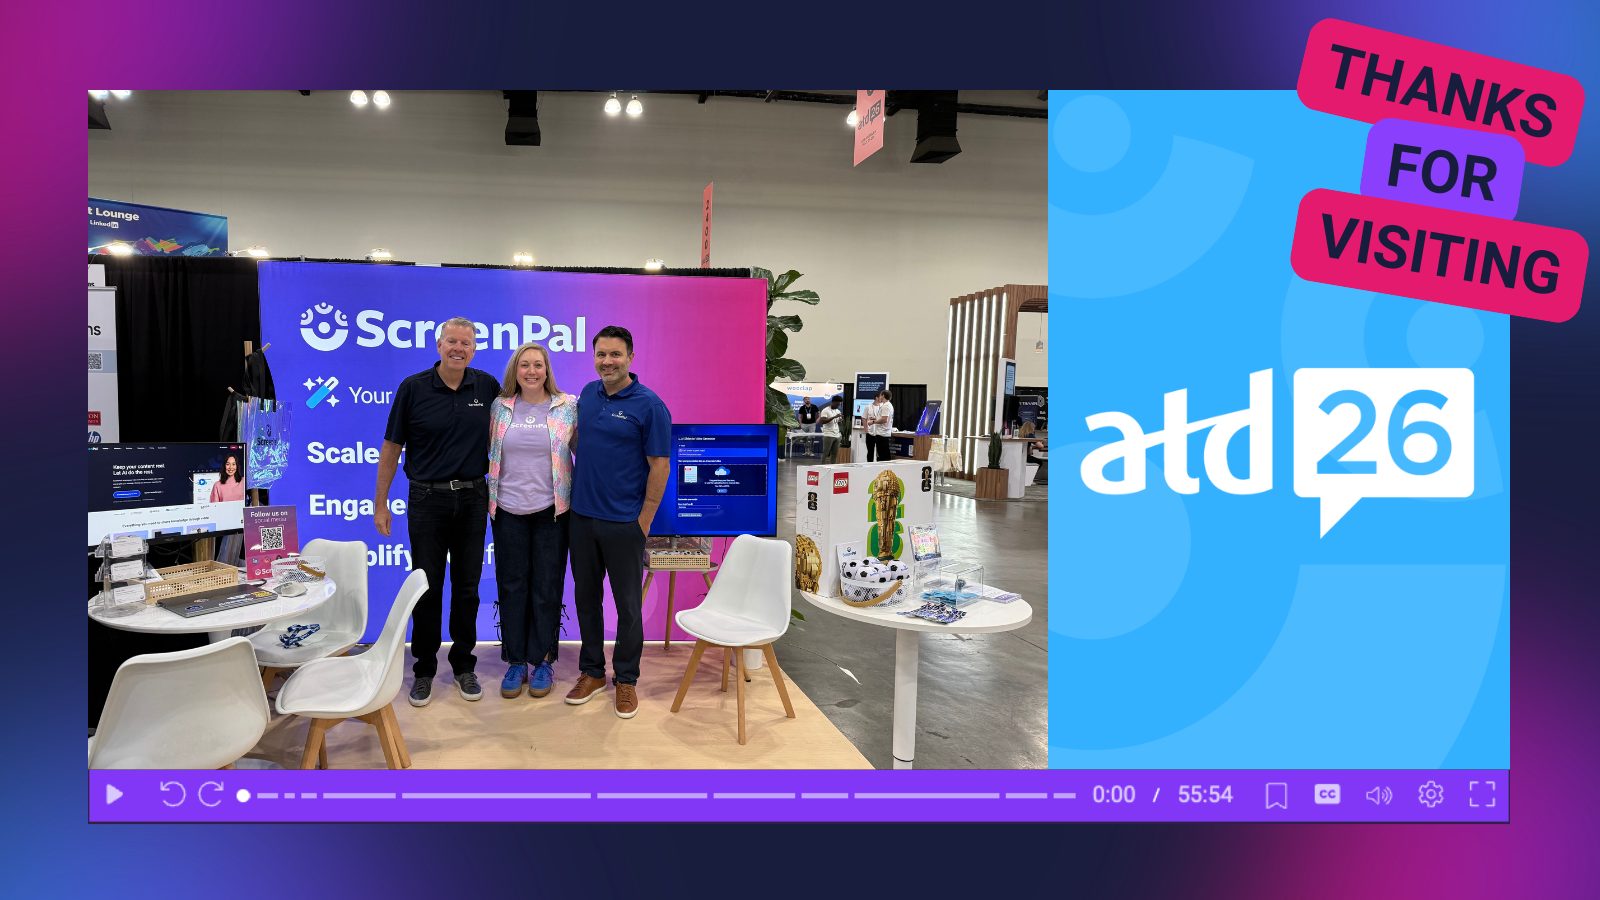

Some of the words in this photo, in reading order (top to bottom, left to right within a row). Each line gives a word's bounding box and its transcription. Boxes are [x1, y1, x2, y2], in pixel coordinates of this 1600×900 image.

[96, 207, 139, 221] Lounge
[356, 310, 586, 352] ScrenPal
[349, 386, 392, 404] Your
[88, 431, 99, 443] hp
[307, 442, 380, 464] Scale
[309, 494, 406, 520] Engae
